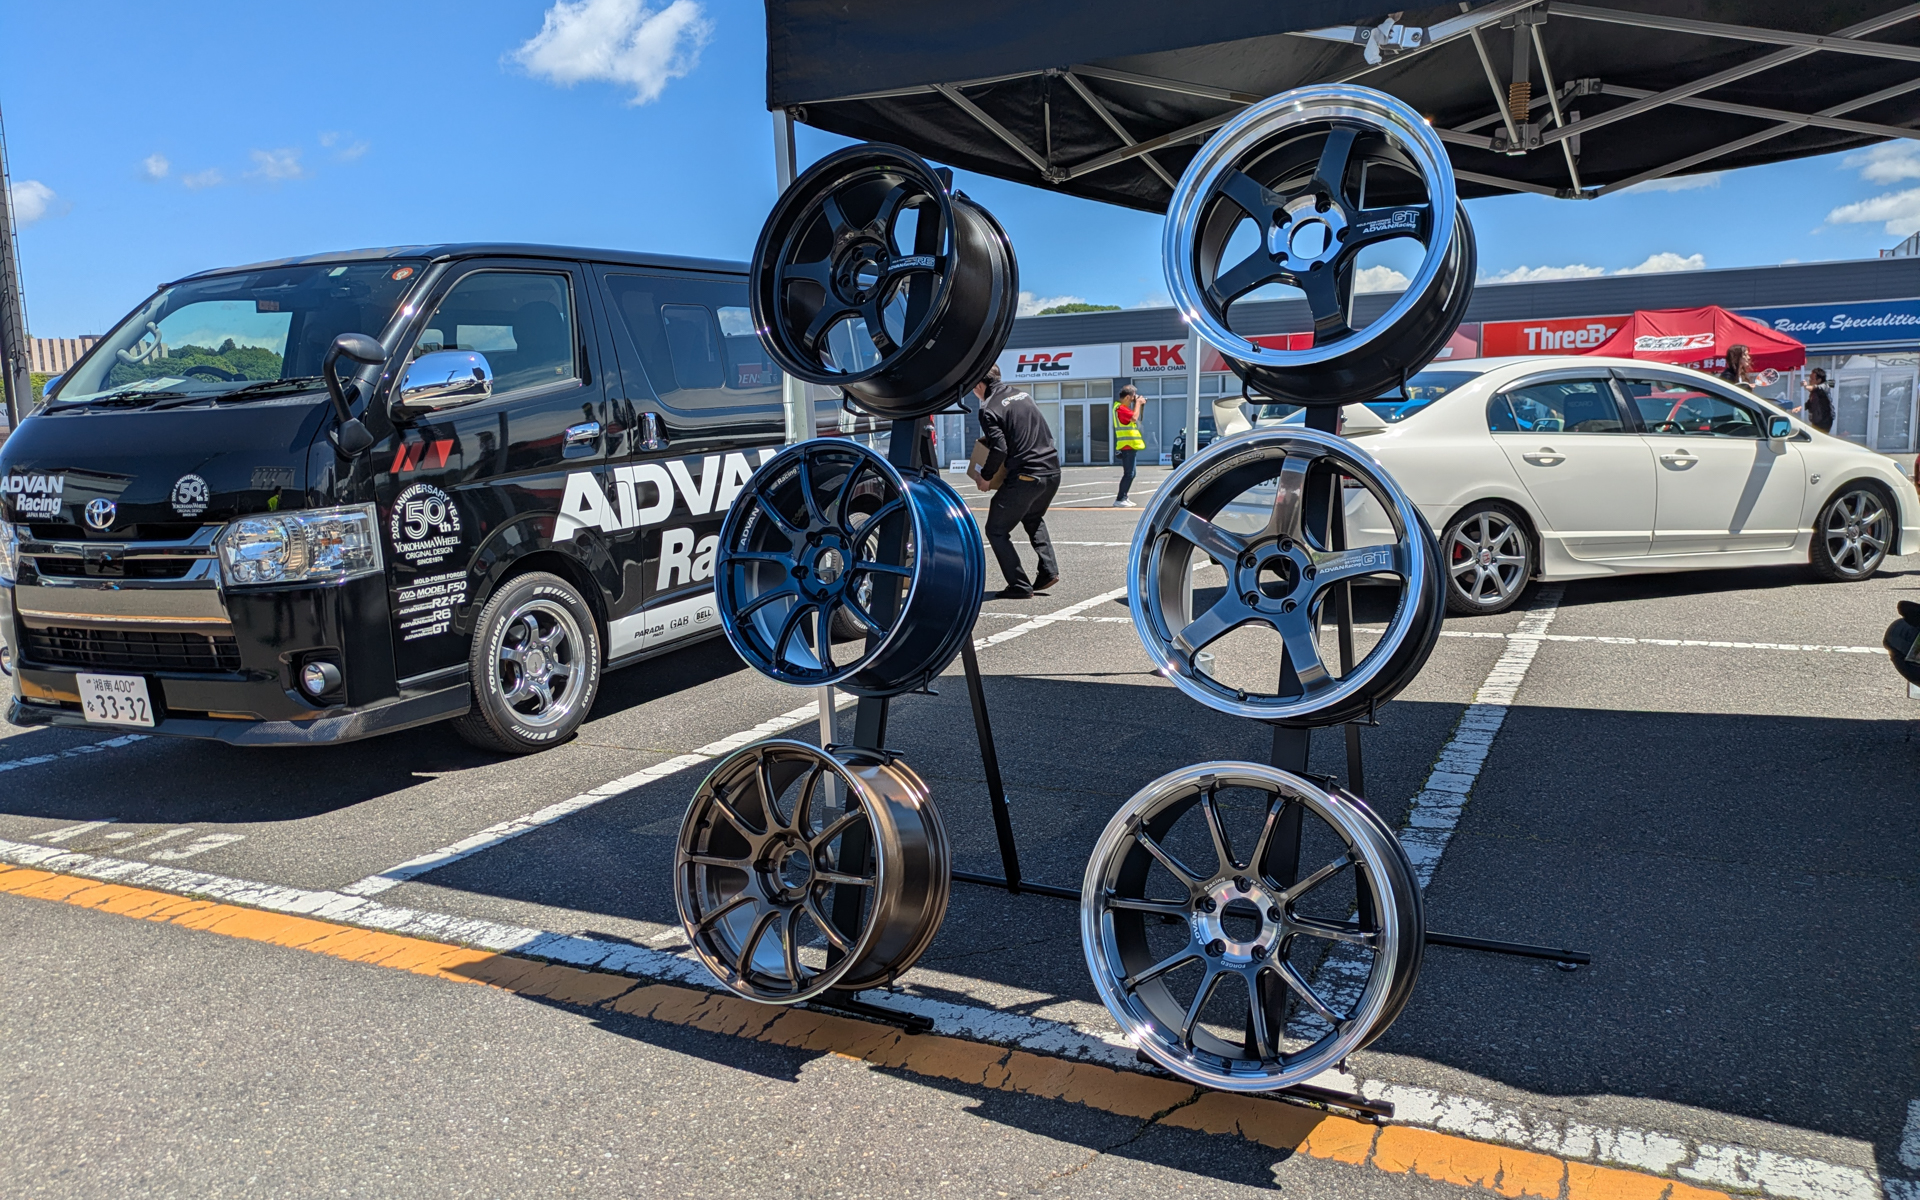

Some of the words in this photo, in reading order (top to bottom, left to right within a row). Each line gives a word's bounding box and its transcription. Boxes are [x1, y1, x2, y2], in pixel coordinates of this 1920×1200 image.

[1392, 210, 1420, 224] GT
[1362, 224, 1394, 234] ADVAN
[1393, 221, 1417, 230] Racing
[1774, 318, 1827, 335] Racing
[1016, 352, 1073, 373] HRC
[1132, 343, 1186, 367] RK
[0, 475, 64, 494] ADVAN
[16, 493, 62, 515] Racing
[394, 484, 450, 514] ANNIVERSARY
[552, 449, 777, 543] ADVA
[740, 507, 760, 546] ADVAN
[777, 468, 797, 485] Racing
[447, 501, 461, 532] YEAR
[391, 514, 400, 540] 2024
[394, 540, 436, 553] YOKOHAMA
[405, 549, 433, 560] ORIGINAL
[432, 546, 454, 557] DESIGN
[1361, 550, 1390, 567] GT
[1319, 564, 1345, 574] ADVAN
[1344, 562, 1362, 570] Racing
[413, 574, 446, 586] MOLD-FORM
[446, 570, 467, 579] FORGED
[416, 585, 447, 598] MODEL
[447, 580, 467, 593] F50
[433, 608, 452, 621] R6
[670, 616, 689, 629] GAB
[696, 611, 712, 621] BELL
[432, 621, 450, 634] GT
[634, 624, 665, 639] PARADA
[488, 615, 506, 695] YOKOHAMA
[588, 633, 598, 682] PARADA
[95, 694, 150, 722] 33-32
[1192, 911, 1205, 945] ADVAN
[1203, 877, 1227, 892] Racing
[1220, 960, 1247, 969] FORGED
